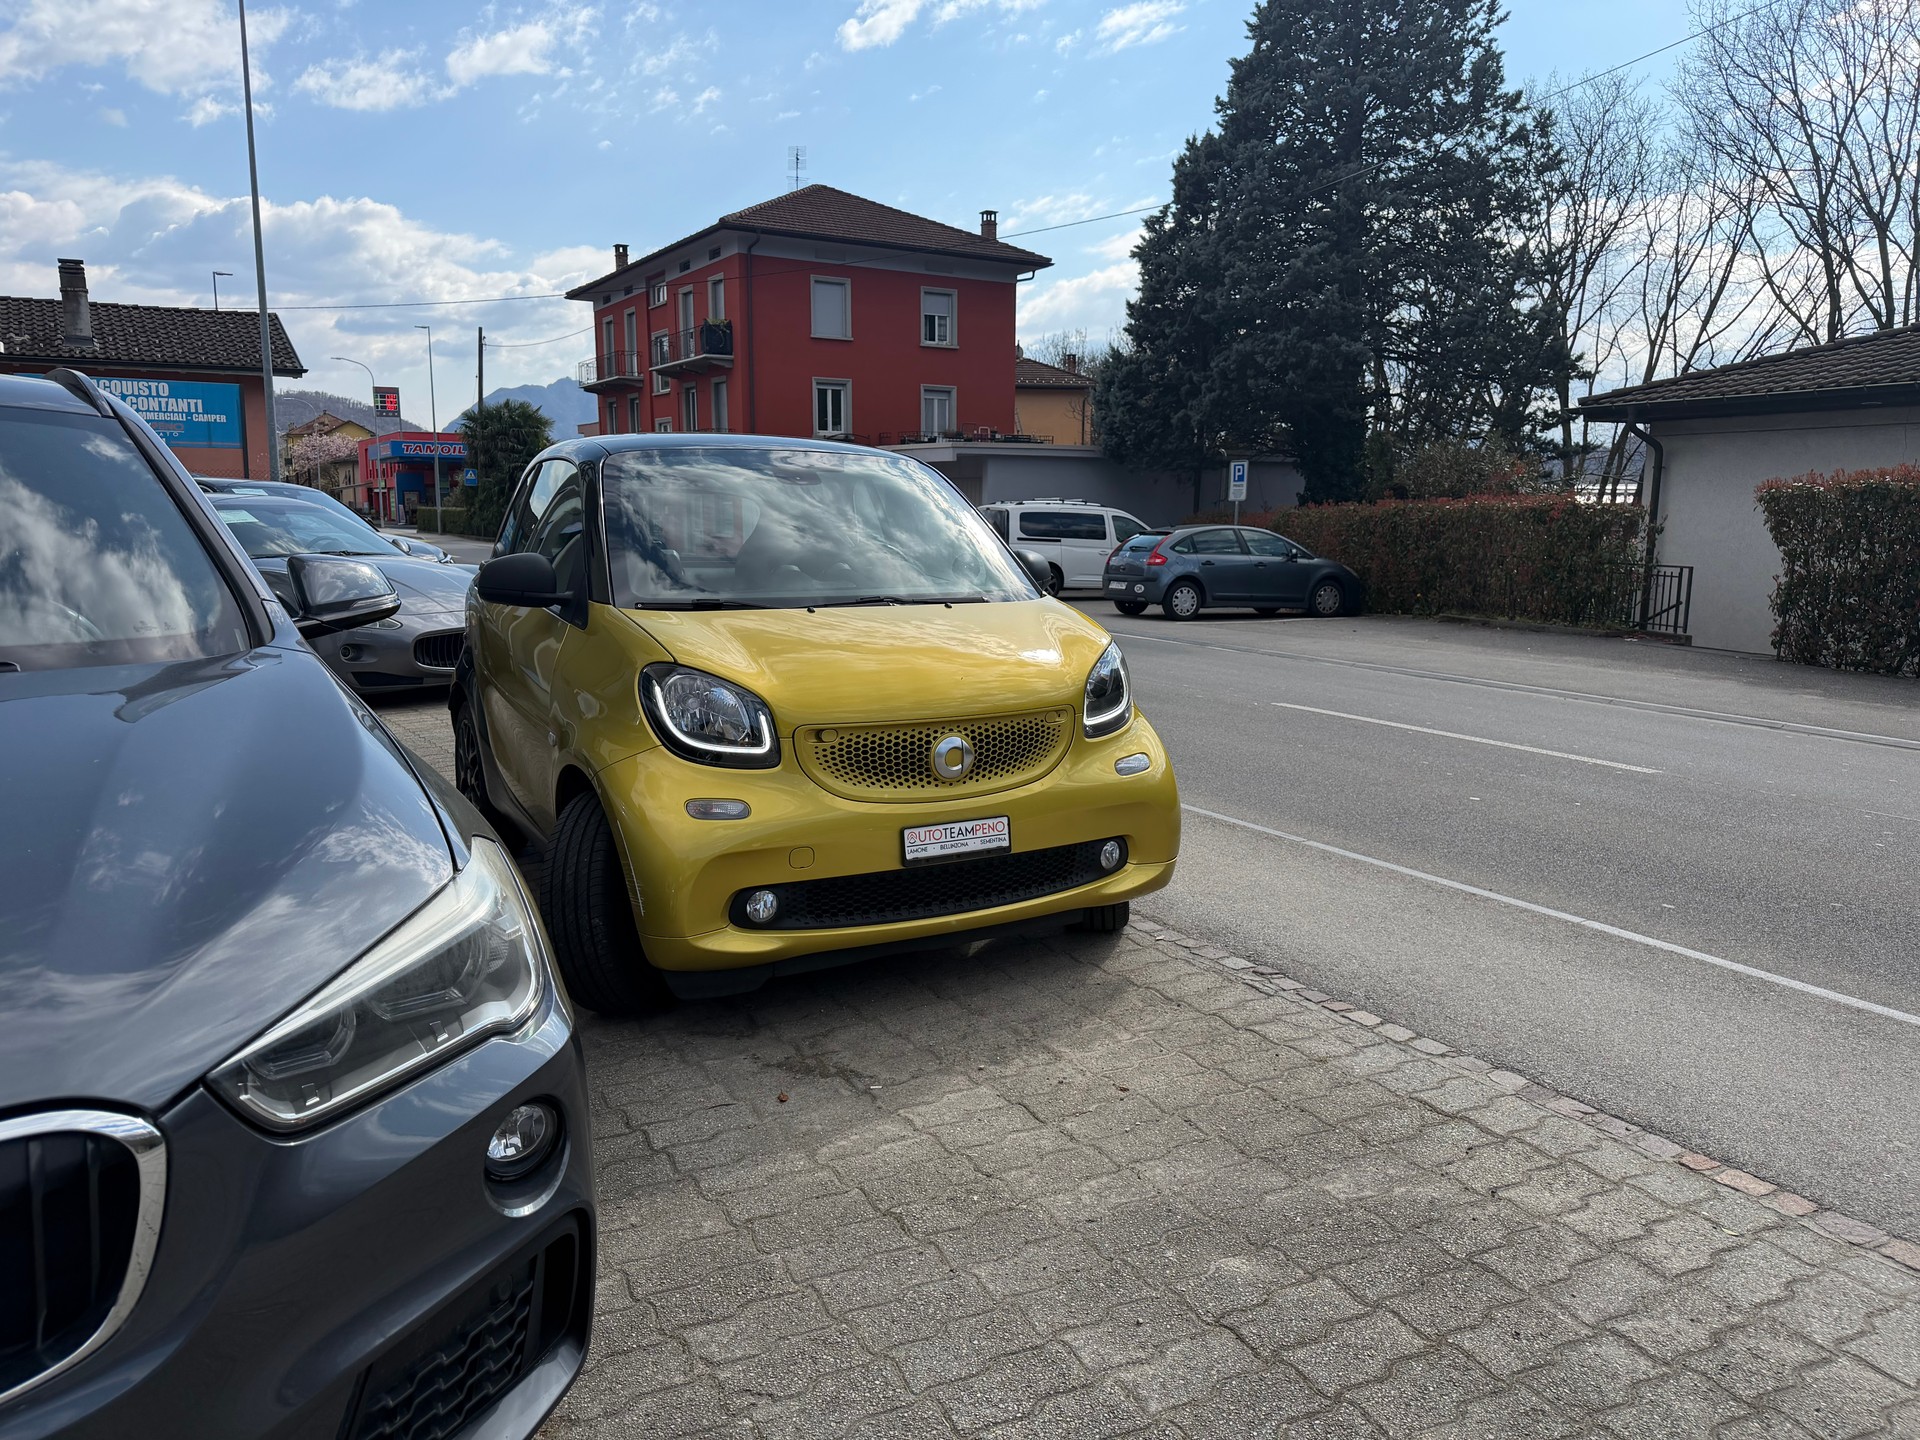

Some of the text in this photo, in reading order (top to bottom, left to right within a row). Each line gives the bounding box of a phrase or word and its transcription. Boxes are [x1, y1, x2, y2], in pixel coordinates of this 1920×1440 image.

[126, 396, 203, 413] CONTANTI
[139, 412, 186, 421] MMERCIALI
[192, 413, 226, 423] CAMPER
[402, 443, 467, 456] TAMOIL
[1235, 465, 1243, 481] P
[907, 836, 1007, 855] LAMONE BELLINZONA SEMENTINA
